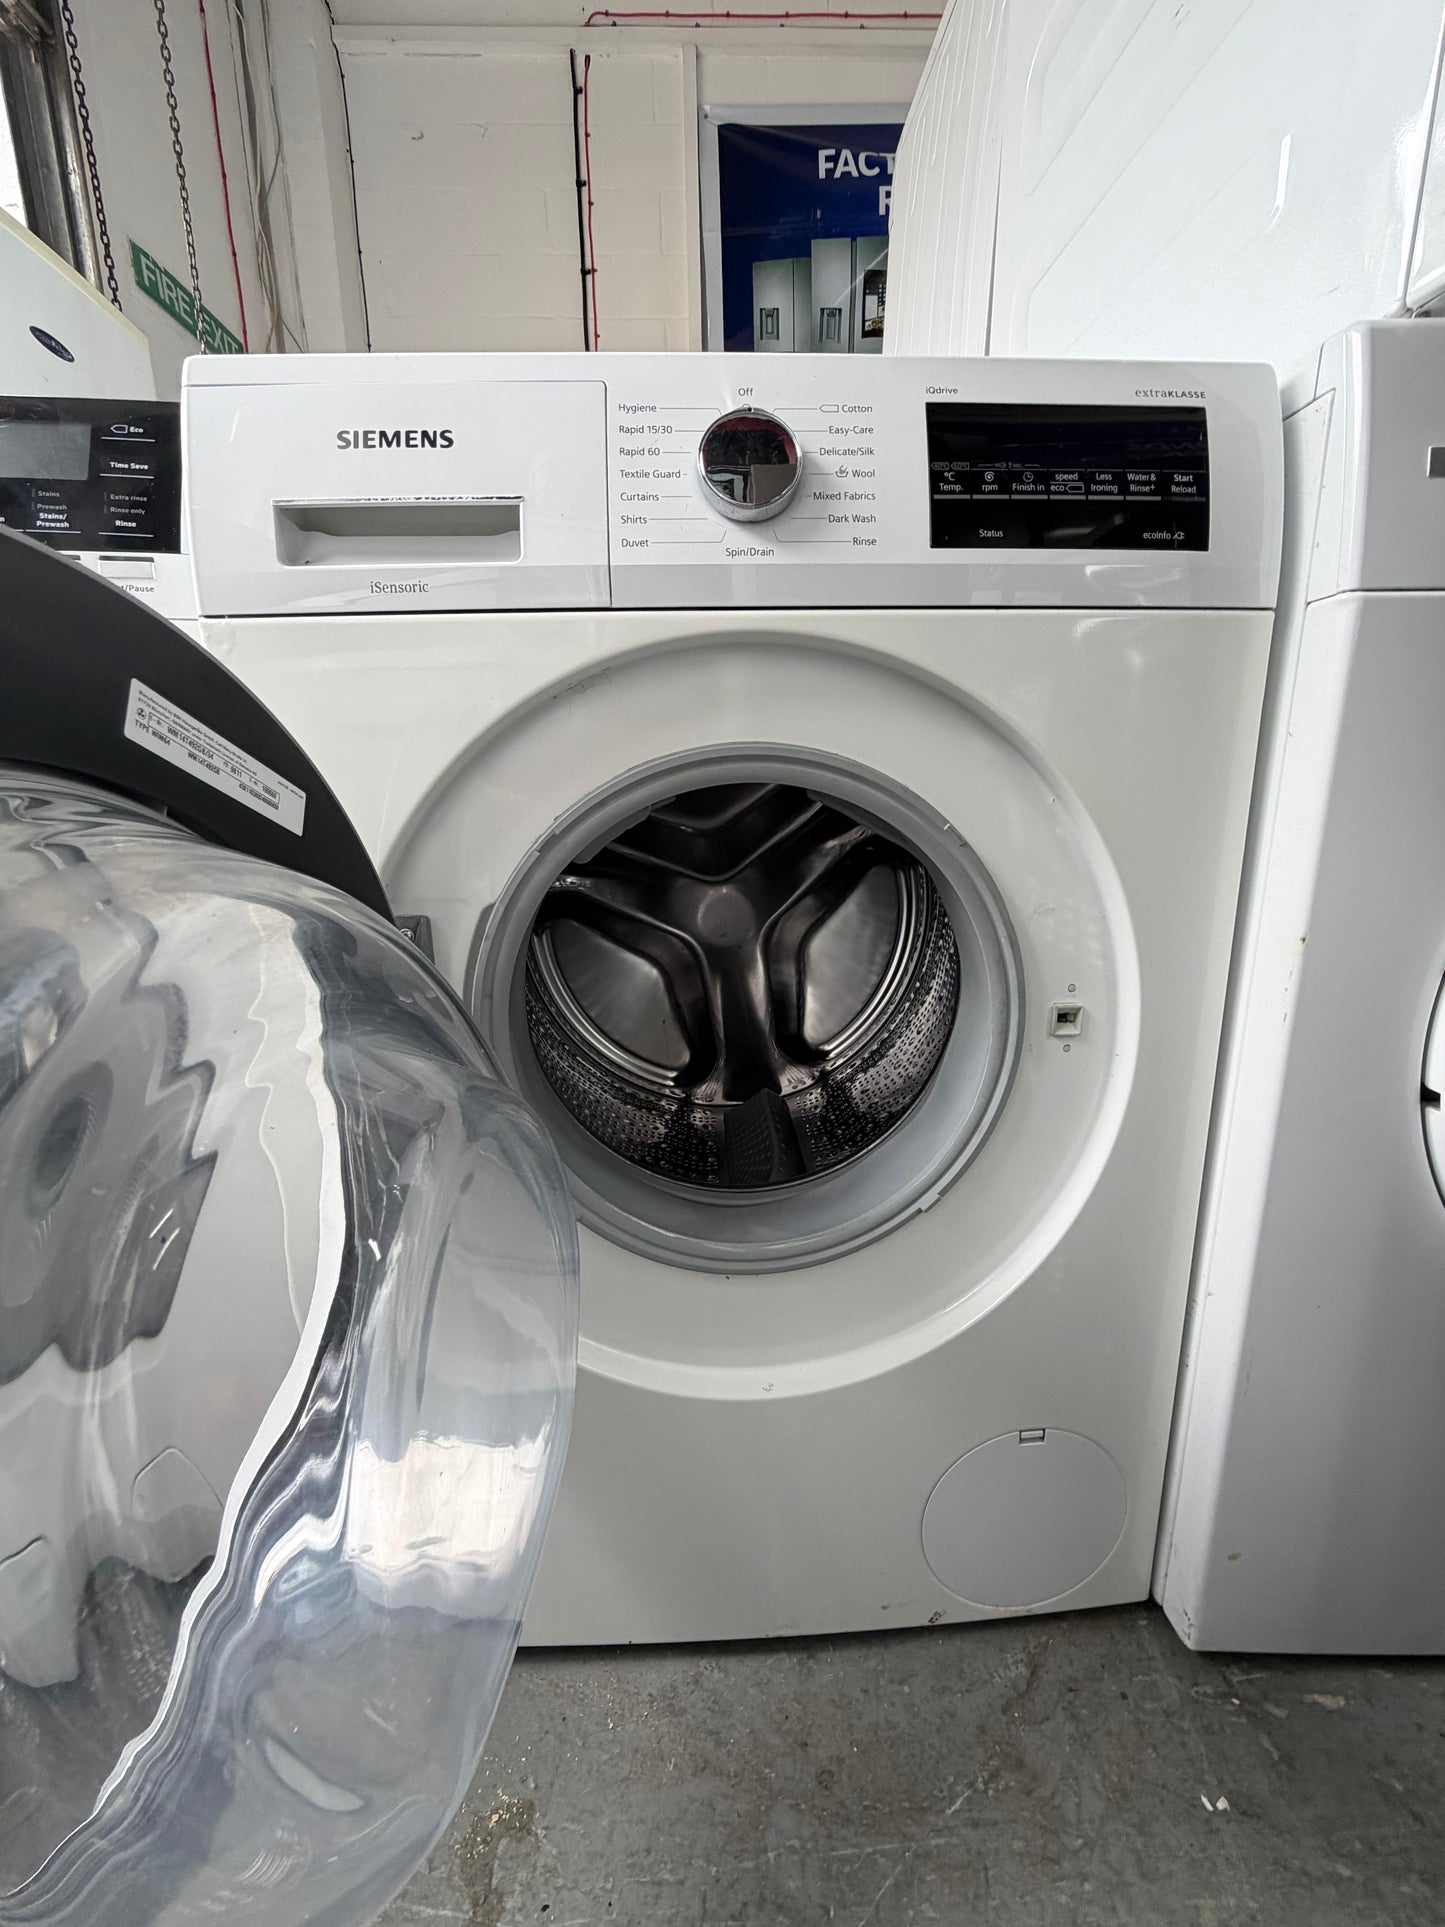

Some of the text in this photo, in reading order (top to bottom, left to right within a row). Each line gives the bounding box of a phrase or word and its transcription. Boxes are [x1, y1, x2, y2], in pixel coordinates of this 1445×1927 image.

[139, 252, 239, 354] FIRE EXIT
[738, 387, 753, 397] Off
[925, 386, 958, 396] iQdrive
[1135, 388, 1207, 399] extraKLASSE
[618, 403, 657, 414] Hygiene
[841, 404, 873, 413] Cotton
[129, 426, 144, 434] Eco
[619, 425, 673, 435] Rapid 15/30
[828, 425, 874, 436] Easy-Care
[336, 429, 454, 450] SIEMENS
[619, 447, 661, 457] Rapid 60
[819, 447, 875, 457] Delicate/Silk
[109, 461, 149, 471] Time Save
[620, 469, 681, 479] Textile Guard
[851, 469, 875, 478] Wool
[1055, 472, 1079, 482] speed
[1095, 472, 1113, 481] Less
[1173, 474, 1194, 482] Start
[938, 482, 964, 493] Temp.
[982, 484, 999, 493] rpm
[1012, 483, 1045, 492] Finish in
[1050, 484, 1065, 492] eco
[1090, 483, 1119, 494] Ironing
[1171, 484, 1197, 494] Reload
[37, 490, 60, 498] Stains
[110, 494, 129, 502] Extra
[620, 492, 659, 502] Curtains
[813, 491, 876, 501] Mixed Fabrics
[36, 503, 68, 511] Prewash
[110, 506, 146, 516] Rinse only
[39, 512, 68, 521] Stains/
[620, 514, 648, 525] Shirts
[828, 514, 877, 523] Dark Wash
[36, 520, 70, 529] Prewash
[115, 519, 137, 528] Rinse
[978, 528, 1004, 538] Status
[621, 538, 649, 548] Duvet
[852, 537, 877, 546] Rinse
[725, 547, 775, 558] Spin/Drain
[370, 580, 429, 594] iSensoric
[134, 718, 150, 733] TYPE
